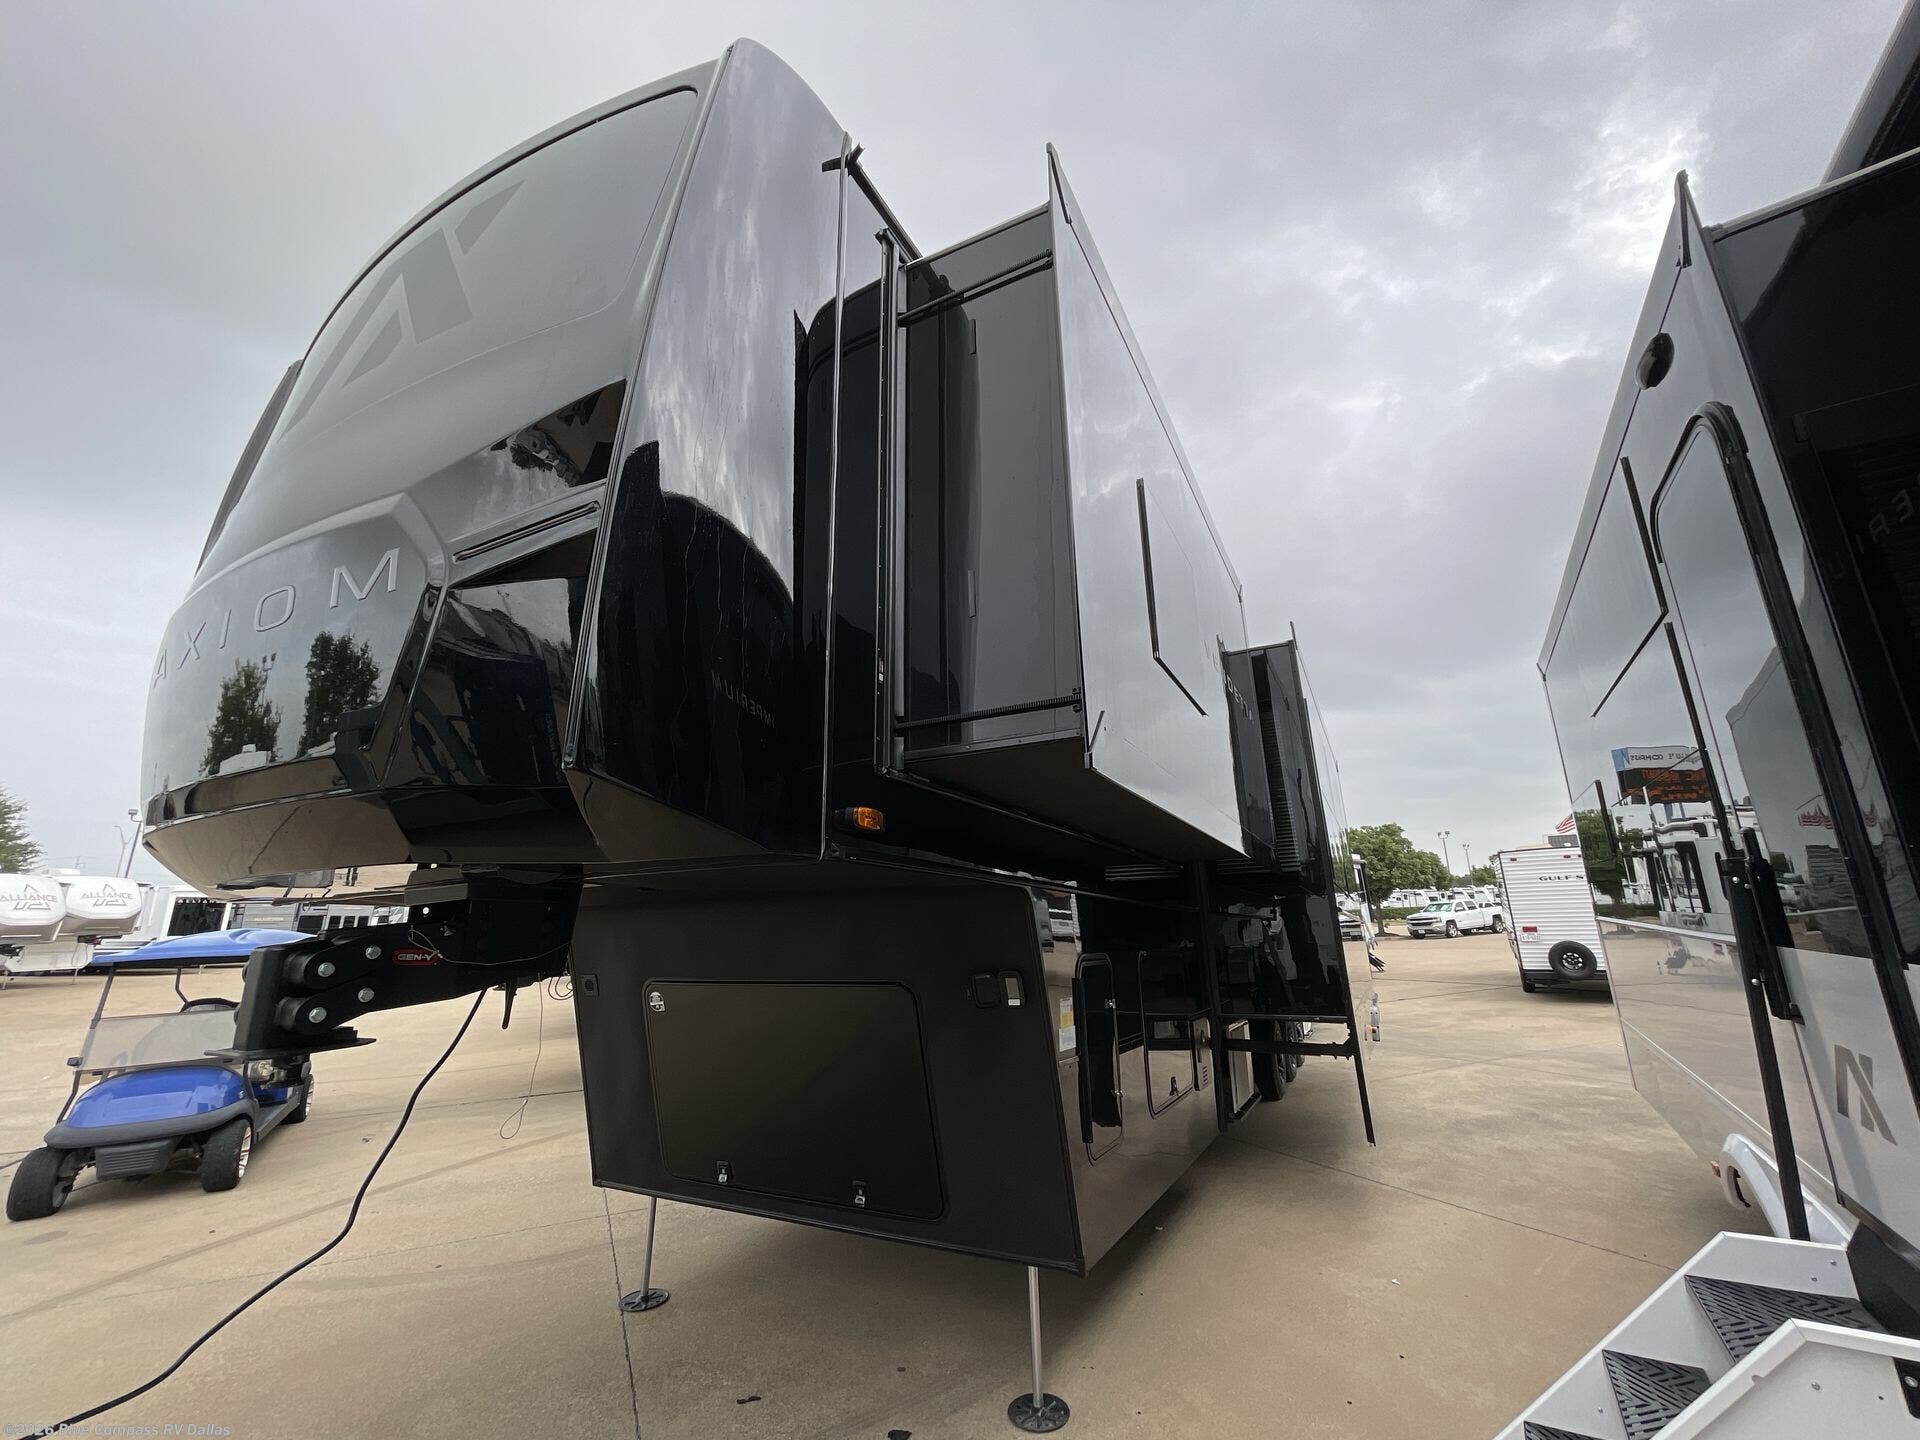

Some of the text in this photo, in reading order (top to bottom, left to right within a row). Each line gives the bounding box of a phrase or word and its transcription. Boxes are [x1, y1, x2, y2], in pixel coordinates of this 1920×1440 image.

[153, 547, 400, 689] AXIOM
[0, 892, 58, 902] ALLIANCE
[80, 891, 134, 900] ALLIANCE
[398, 953, 434, 961] GEN-Y
